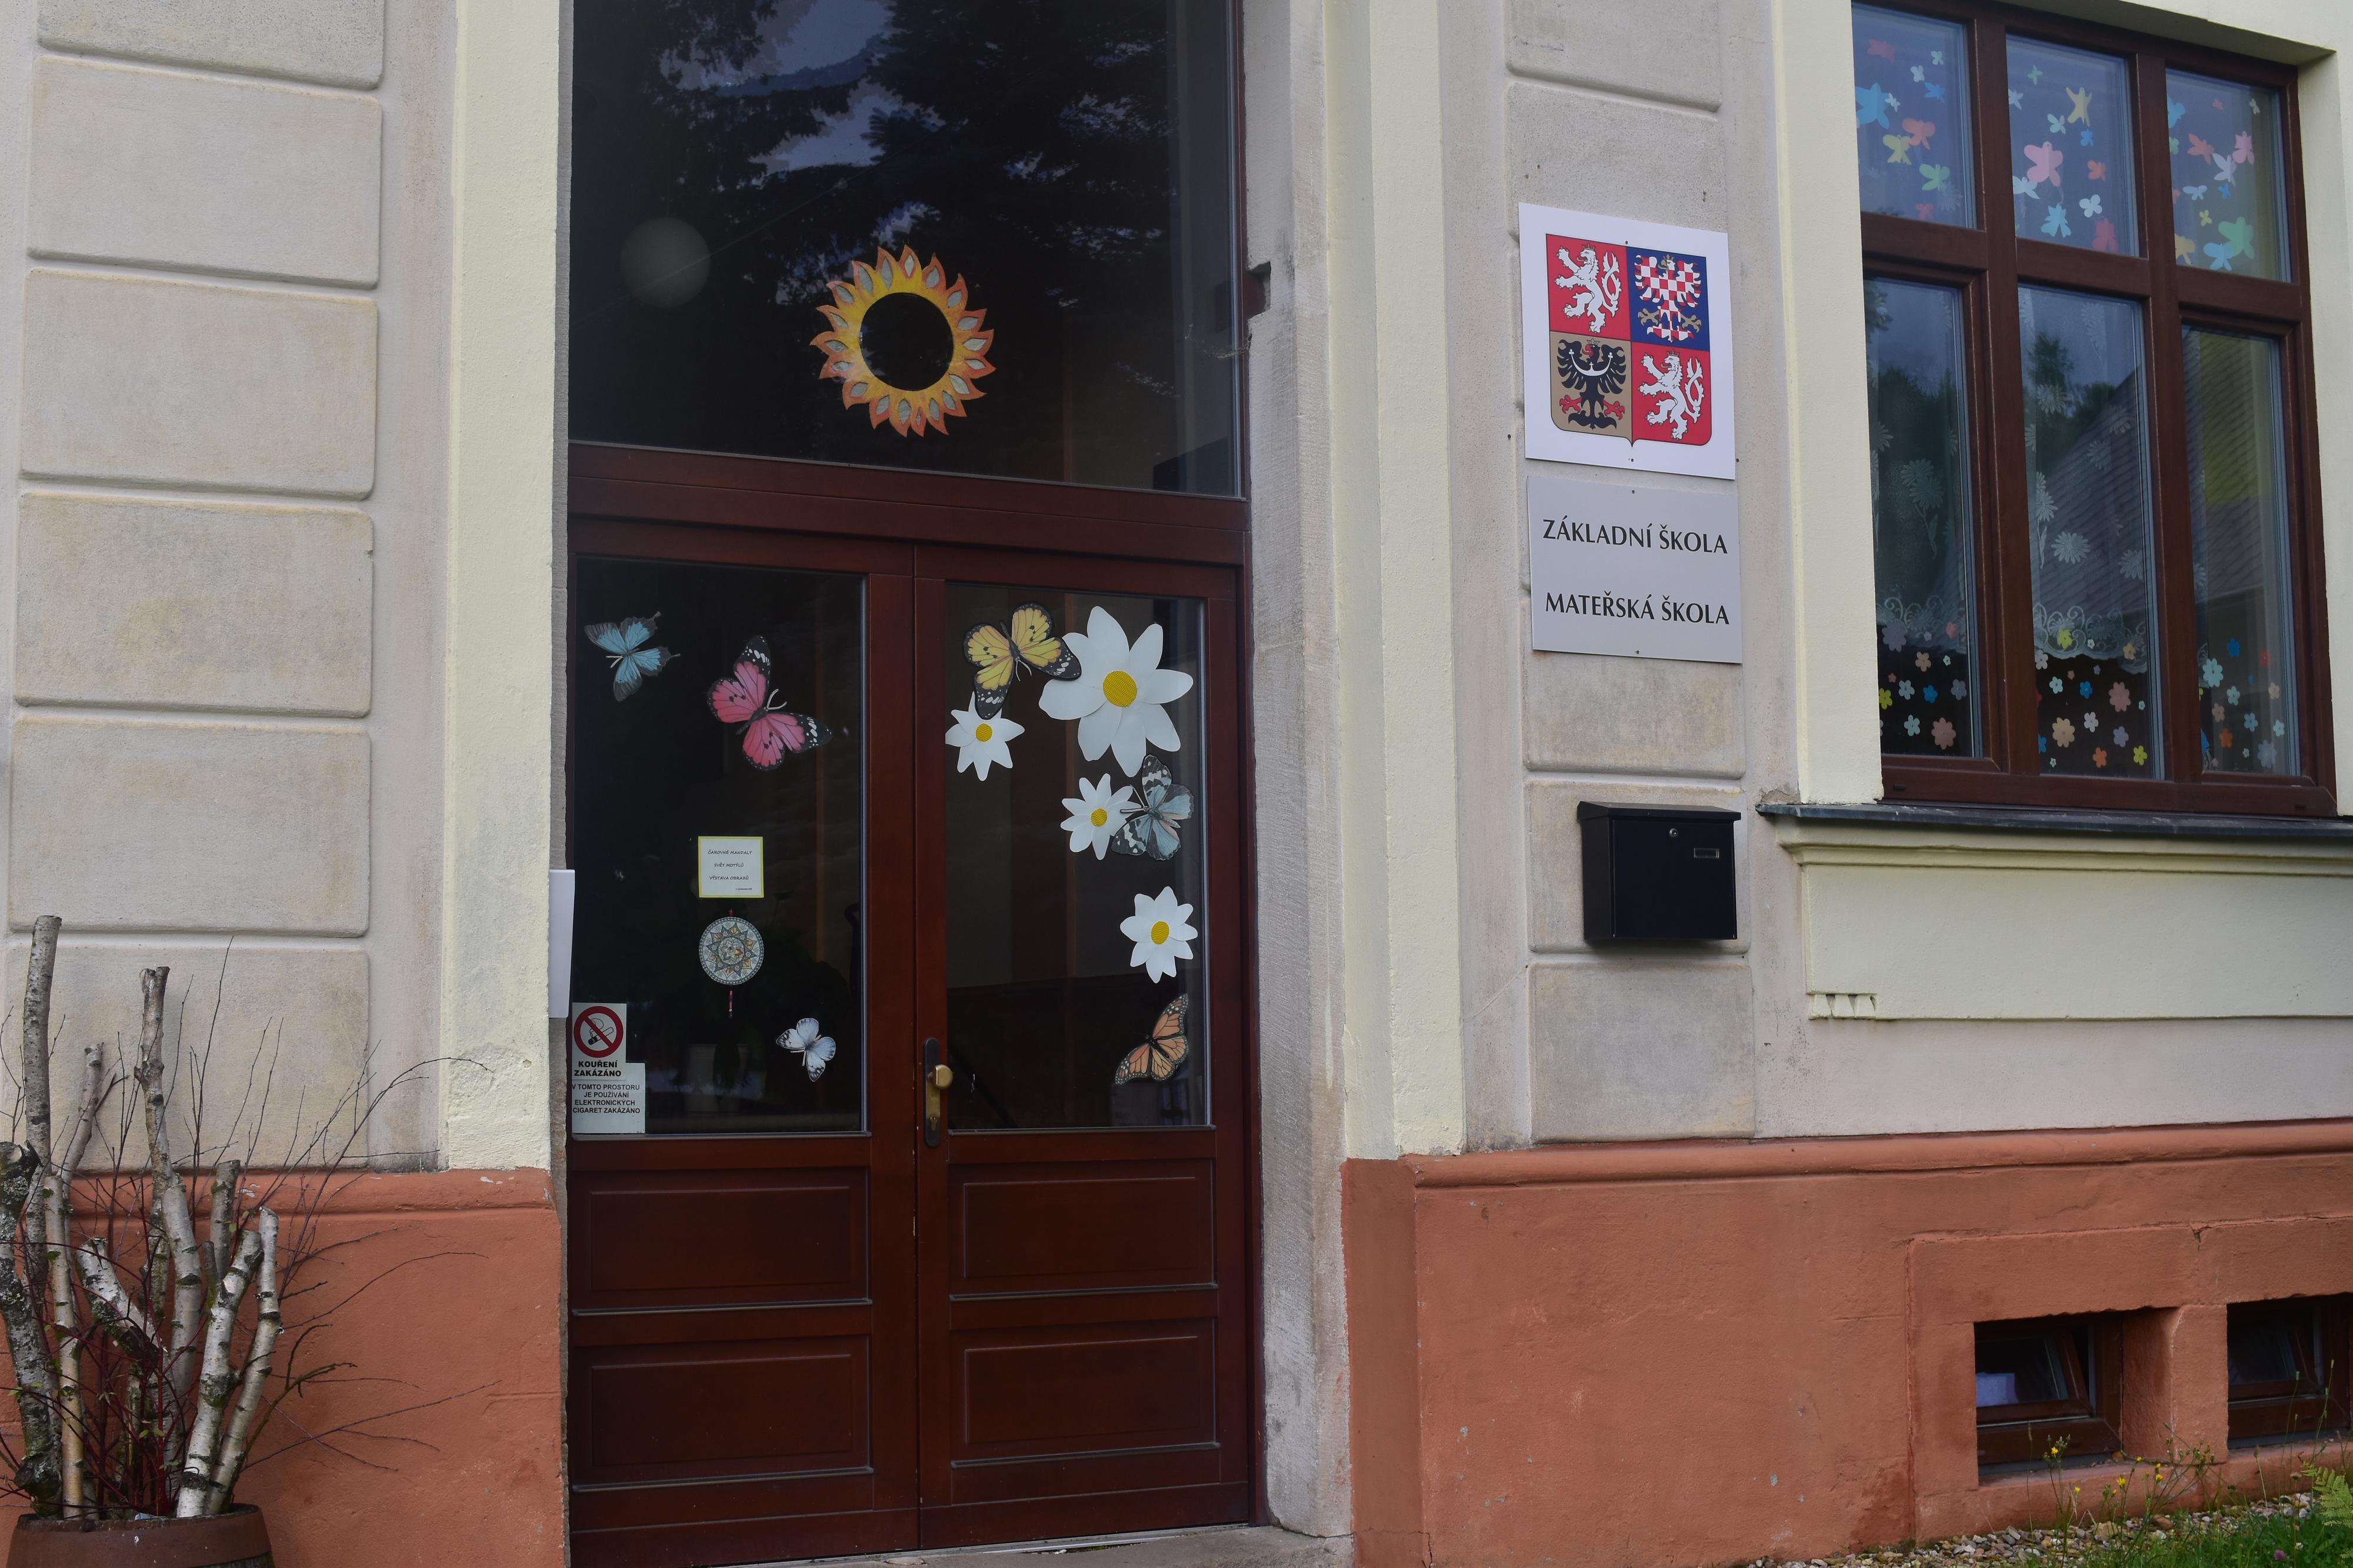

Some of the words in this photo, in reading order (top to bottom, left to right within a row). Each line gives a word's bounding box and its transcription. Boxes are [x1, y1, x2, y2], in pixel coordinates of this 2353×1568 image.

[1543, 515, 1652, 548] ZÁKLADNÍ
[1659, 524, 1728, 554] ŠKOLA
[1545, 590, 1654, 619] MATEŘSKÁ
[1661, 595, 1729, 625] ŠKOLA
